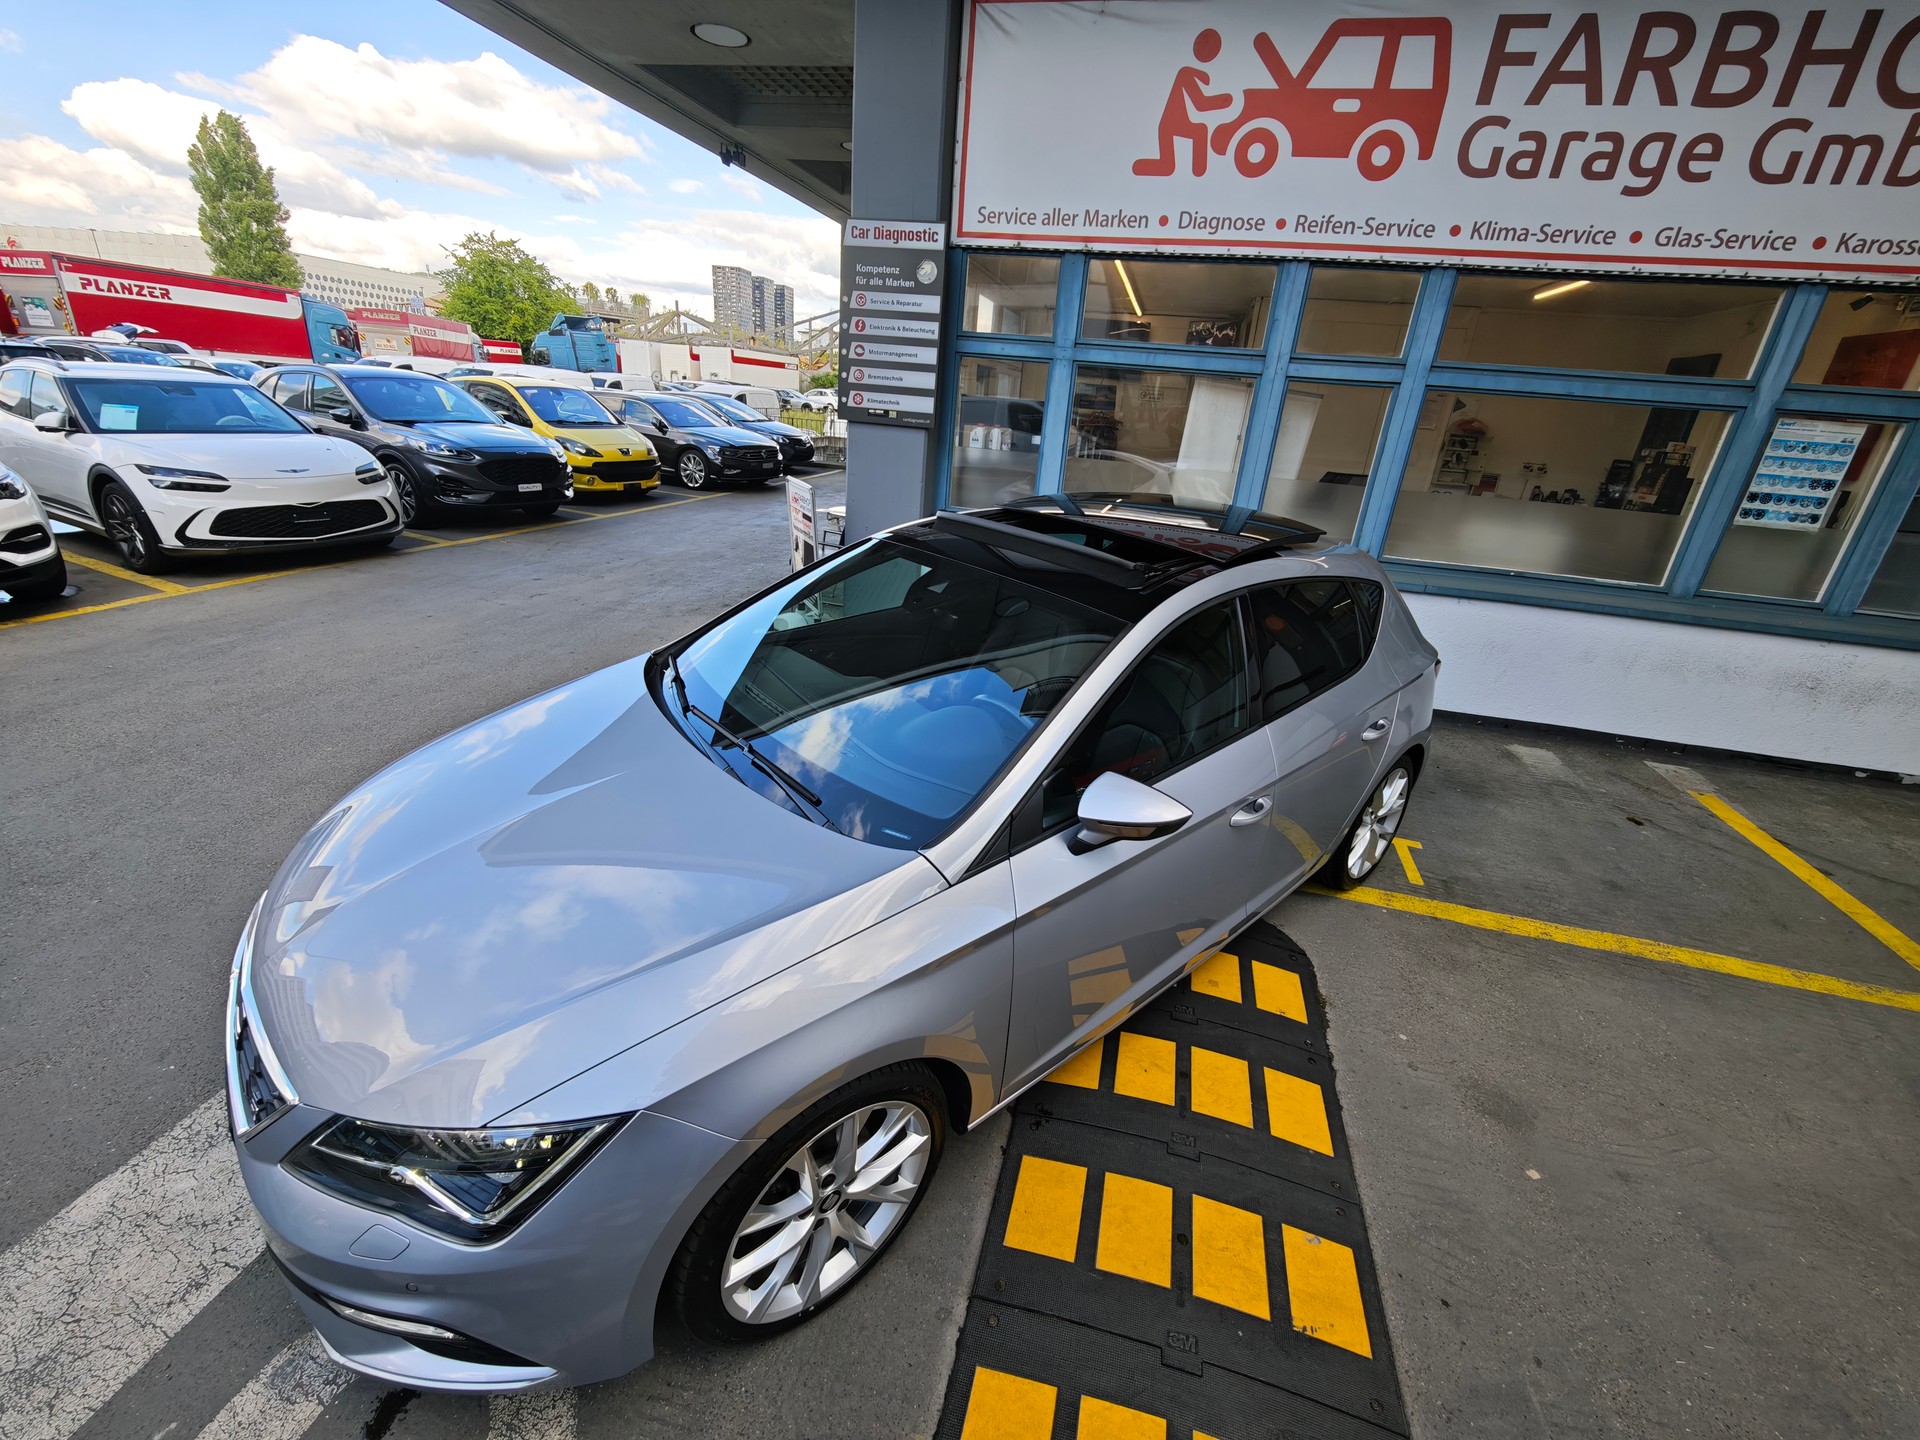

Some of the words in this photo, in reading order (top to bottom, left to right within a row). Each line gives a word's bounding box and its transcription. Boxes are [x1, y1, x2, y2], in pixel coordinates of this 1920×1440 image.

[1457, 115, 1724, 197] Garage
[851, 225, 870, 240] Car
[873, 225, 939, 244] Diagnostic
[977, 206, 1037, 226] Service
[1041, 207, 1079, 227] aller
[1083, 209, 1149, 229] Marken
[1177, 210, 1266, 234] Diagnose
[1293, 214, 1436, 239] Reifen-Service
[1469, 221, 1616, 246] Klima-Service
[1654, 226, 1797, 252] Glas-Service
[1835, 232, 1920, 256] Kaross
[0, 256, 46, 270] PLANZER
[856, 263, 900, 275] Kompetenz
[855, 276, 867, 286] für
[869, 277, 883, 286] alle
[885, 278, 915, 288] Marken
[79, 276, 173, 301] PLANZER
[870, 298, 889, 306] Service
[896, 300, 923, 308] Reparatur
[362, 311, 401, 321] PLANZER
[413, 326, 438, 337] PLANZER
[869, 324, 896, 332] Elektronik
[902, 326, 935, 335] Beleuchtung
[868, 349, 918, 359] Motormanagement
[867, 374, 904, 382] Bremstechnik
[867, 398, 900, 406] Klimatechnik
